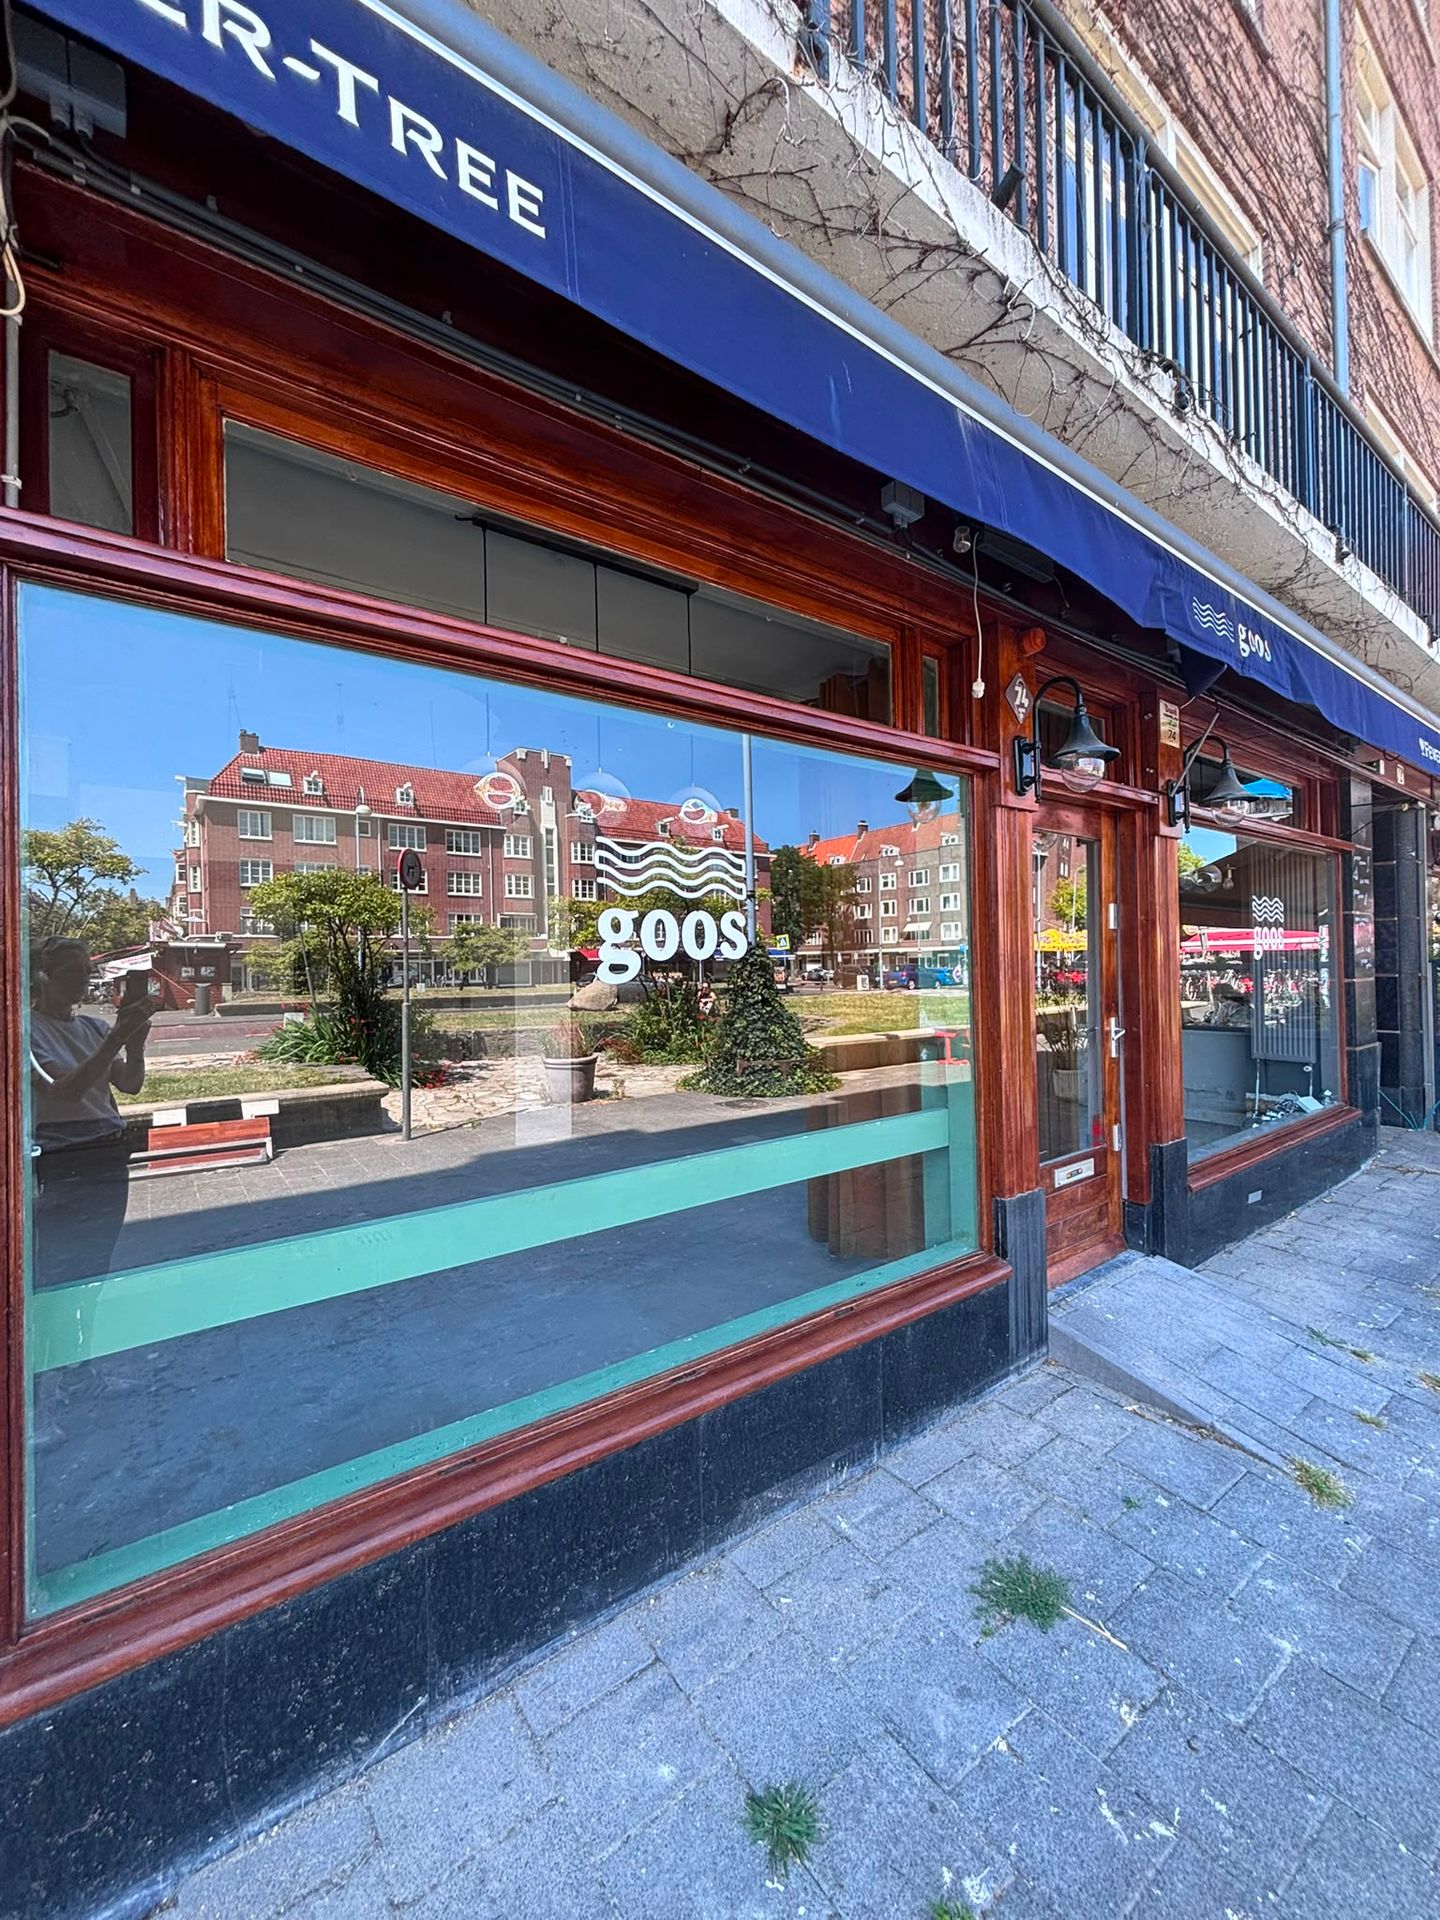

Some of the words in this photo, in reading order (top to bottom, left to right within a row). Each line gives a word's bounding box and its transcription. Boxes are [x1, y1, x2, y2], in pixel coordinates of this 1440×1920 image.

[1237, 623, 1271, 662] goos
[1014, 685, 1029, 707] 74
[597, 908, 748, 984] goos
[1253, 926, 1284, 960] goos
